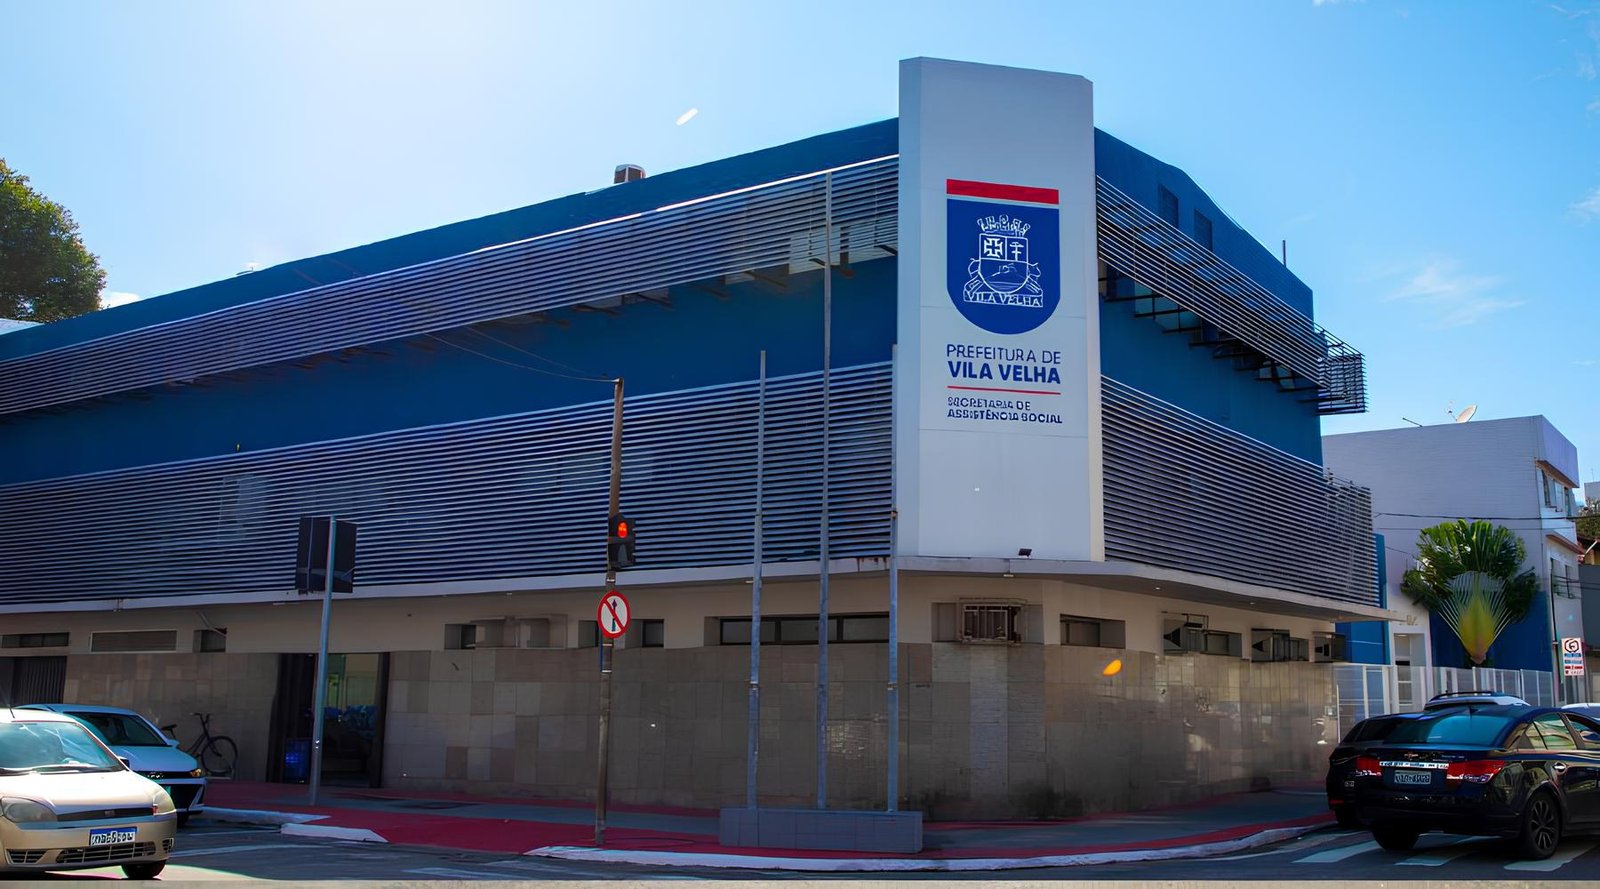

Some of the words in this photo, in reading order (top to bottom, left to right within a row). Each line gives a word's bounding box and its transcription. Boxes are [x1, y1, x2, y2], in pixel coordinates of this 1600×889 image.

[946, 344, 1036, 362] PREFEITURA
[1042, 350, 1061, 364] DE
[948, 361, 993, 380] VILA
[998, 364, 1061, 384] VELHA
[1016, 401, 1031, 411] DE
[1021, 413, 1063, 424] SOCIAL
